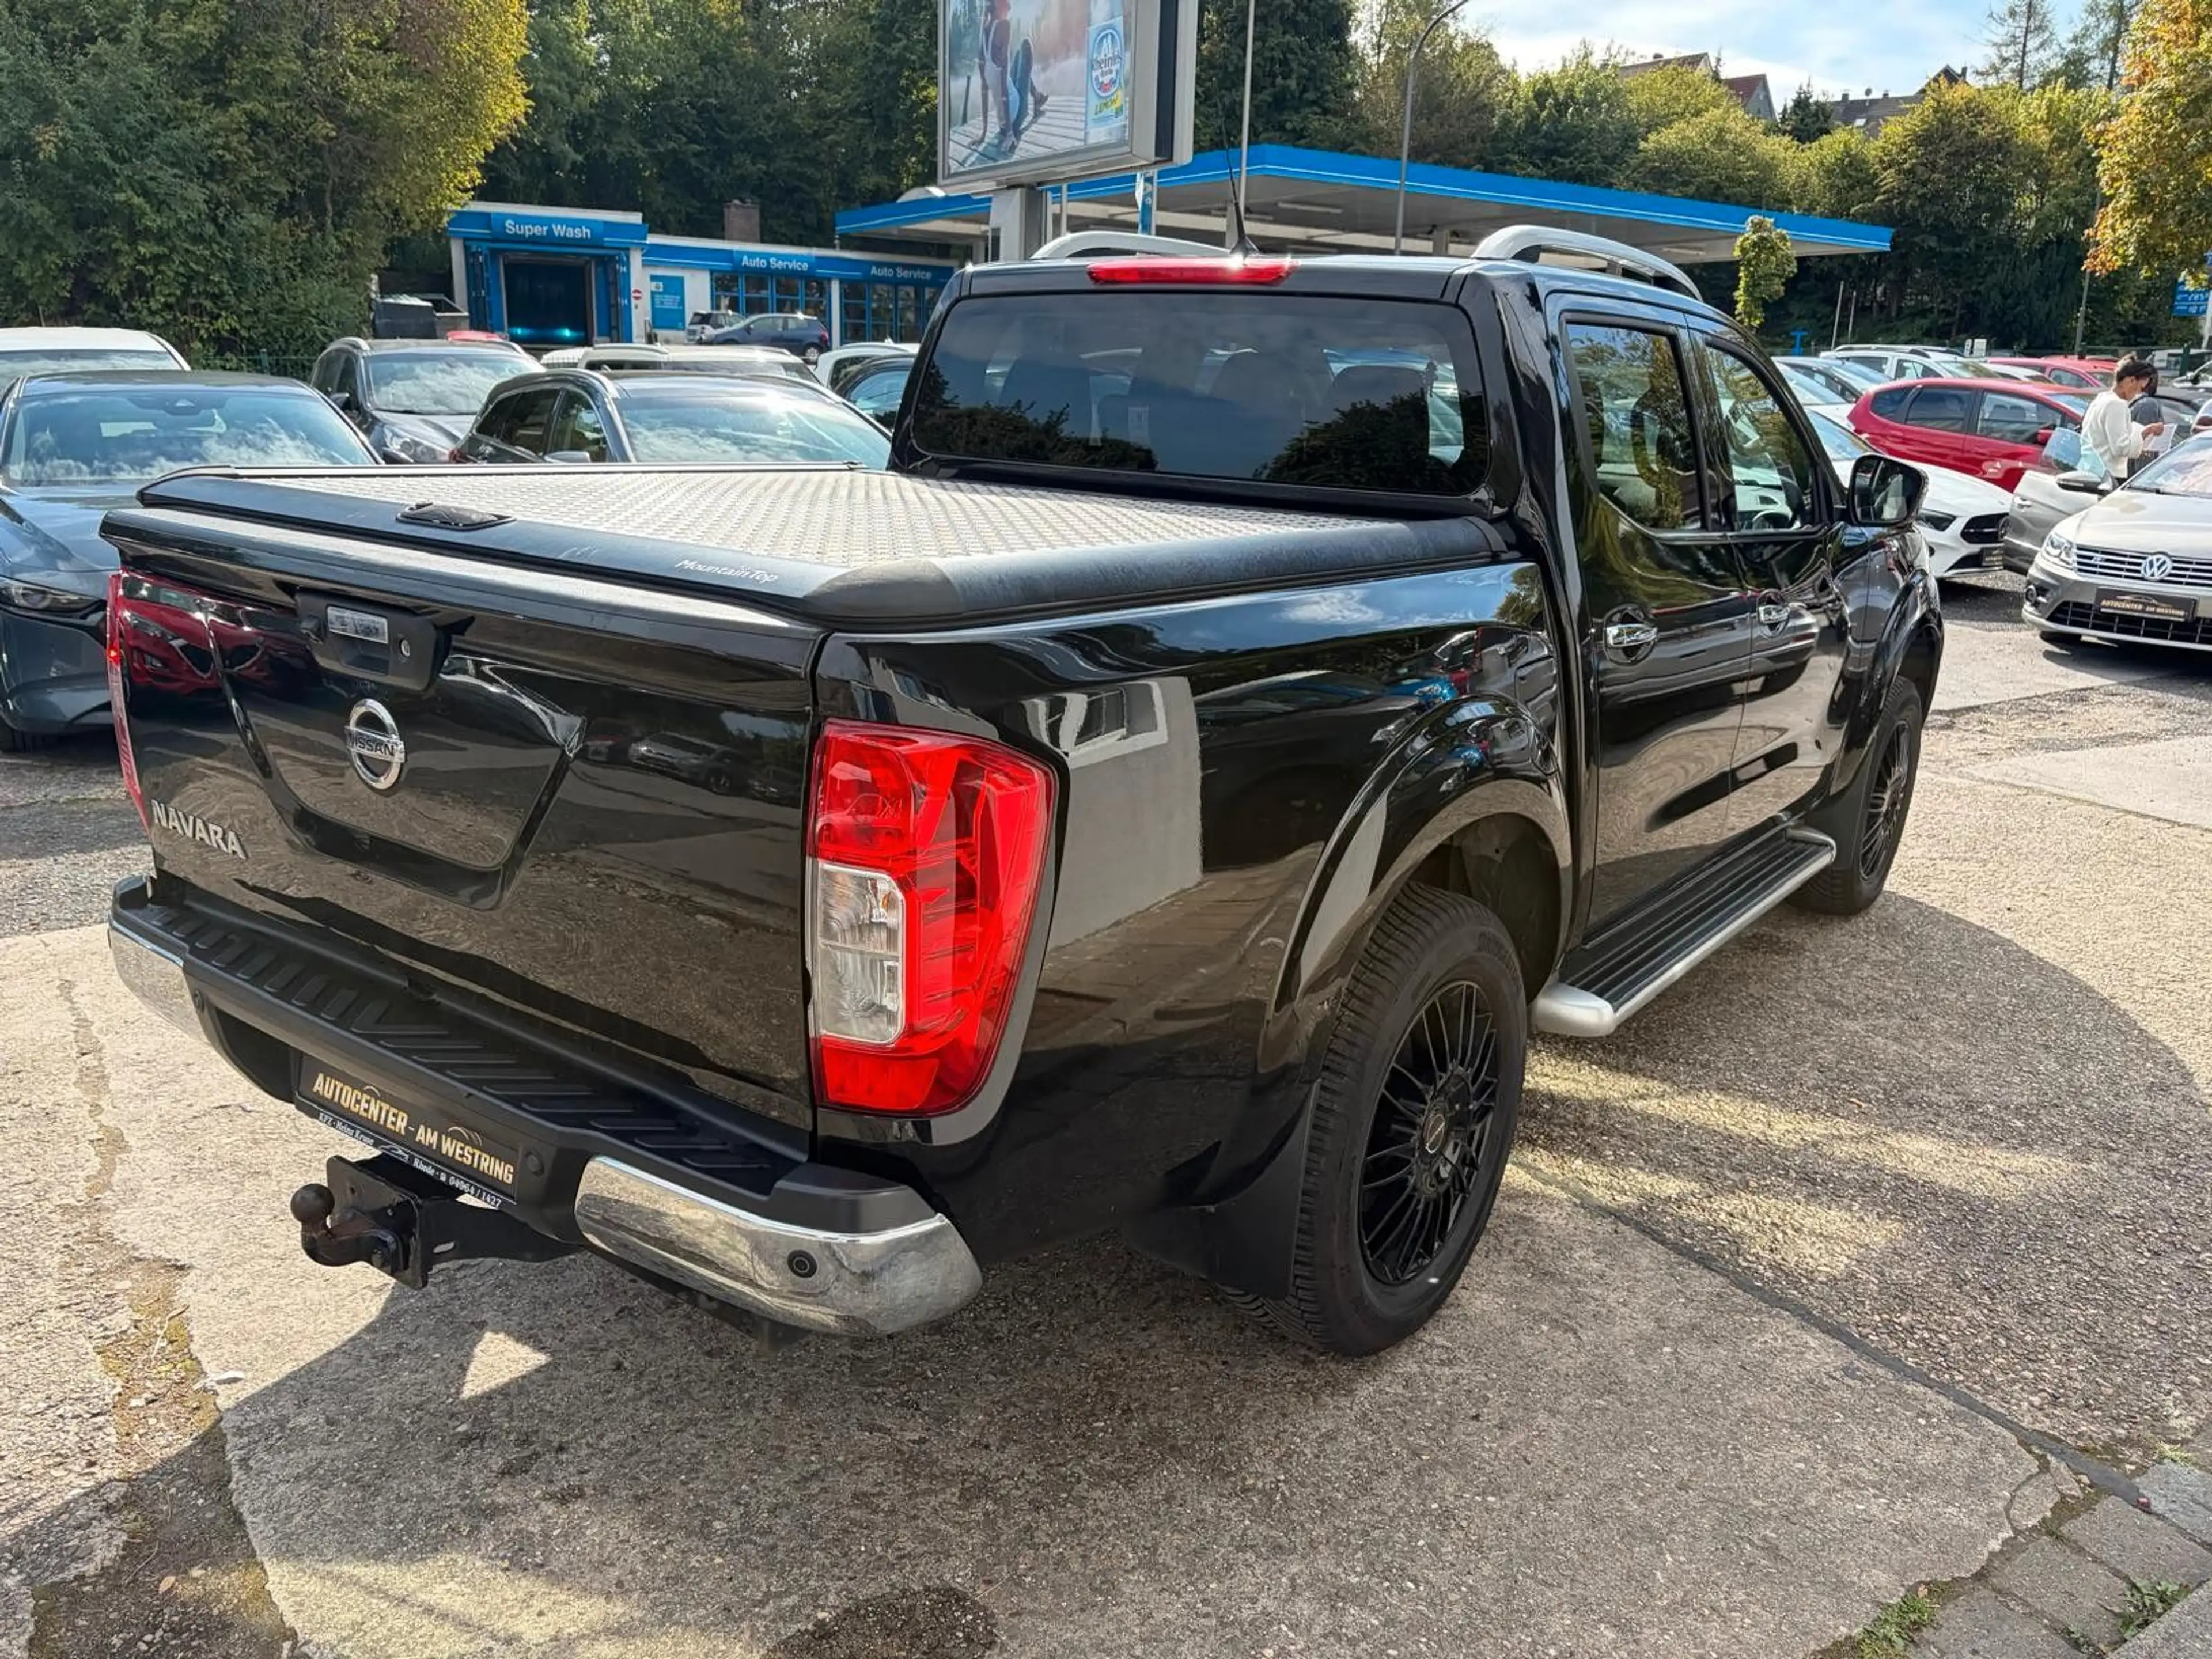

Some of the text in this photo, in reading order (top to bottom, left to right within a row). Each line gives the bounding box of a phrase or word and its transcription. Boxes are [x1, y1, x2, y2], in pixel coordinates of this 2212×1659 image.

[505, 218, 591, 240] Super Wash
[741, 255, 809, 271] Auto Service
[871, 264, 932, 281] Auto Service
[349, 732, 395, 757] NISSAN
[151, 798, 247, 860] NAVARA
[313, 1071, 409, 1136] AUTOCENTER
[415, 1124, 438, 1150] AM
[441, 1134, 514, 1185] WESTRING
